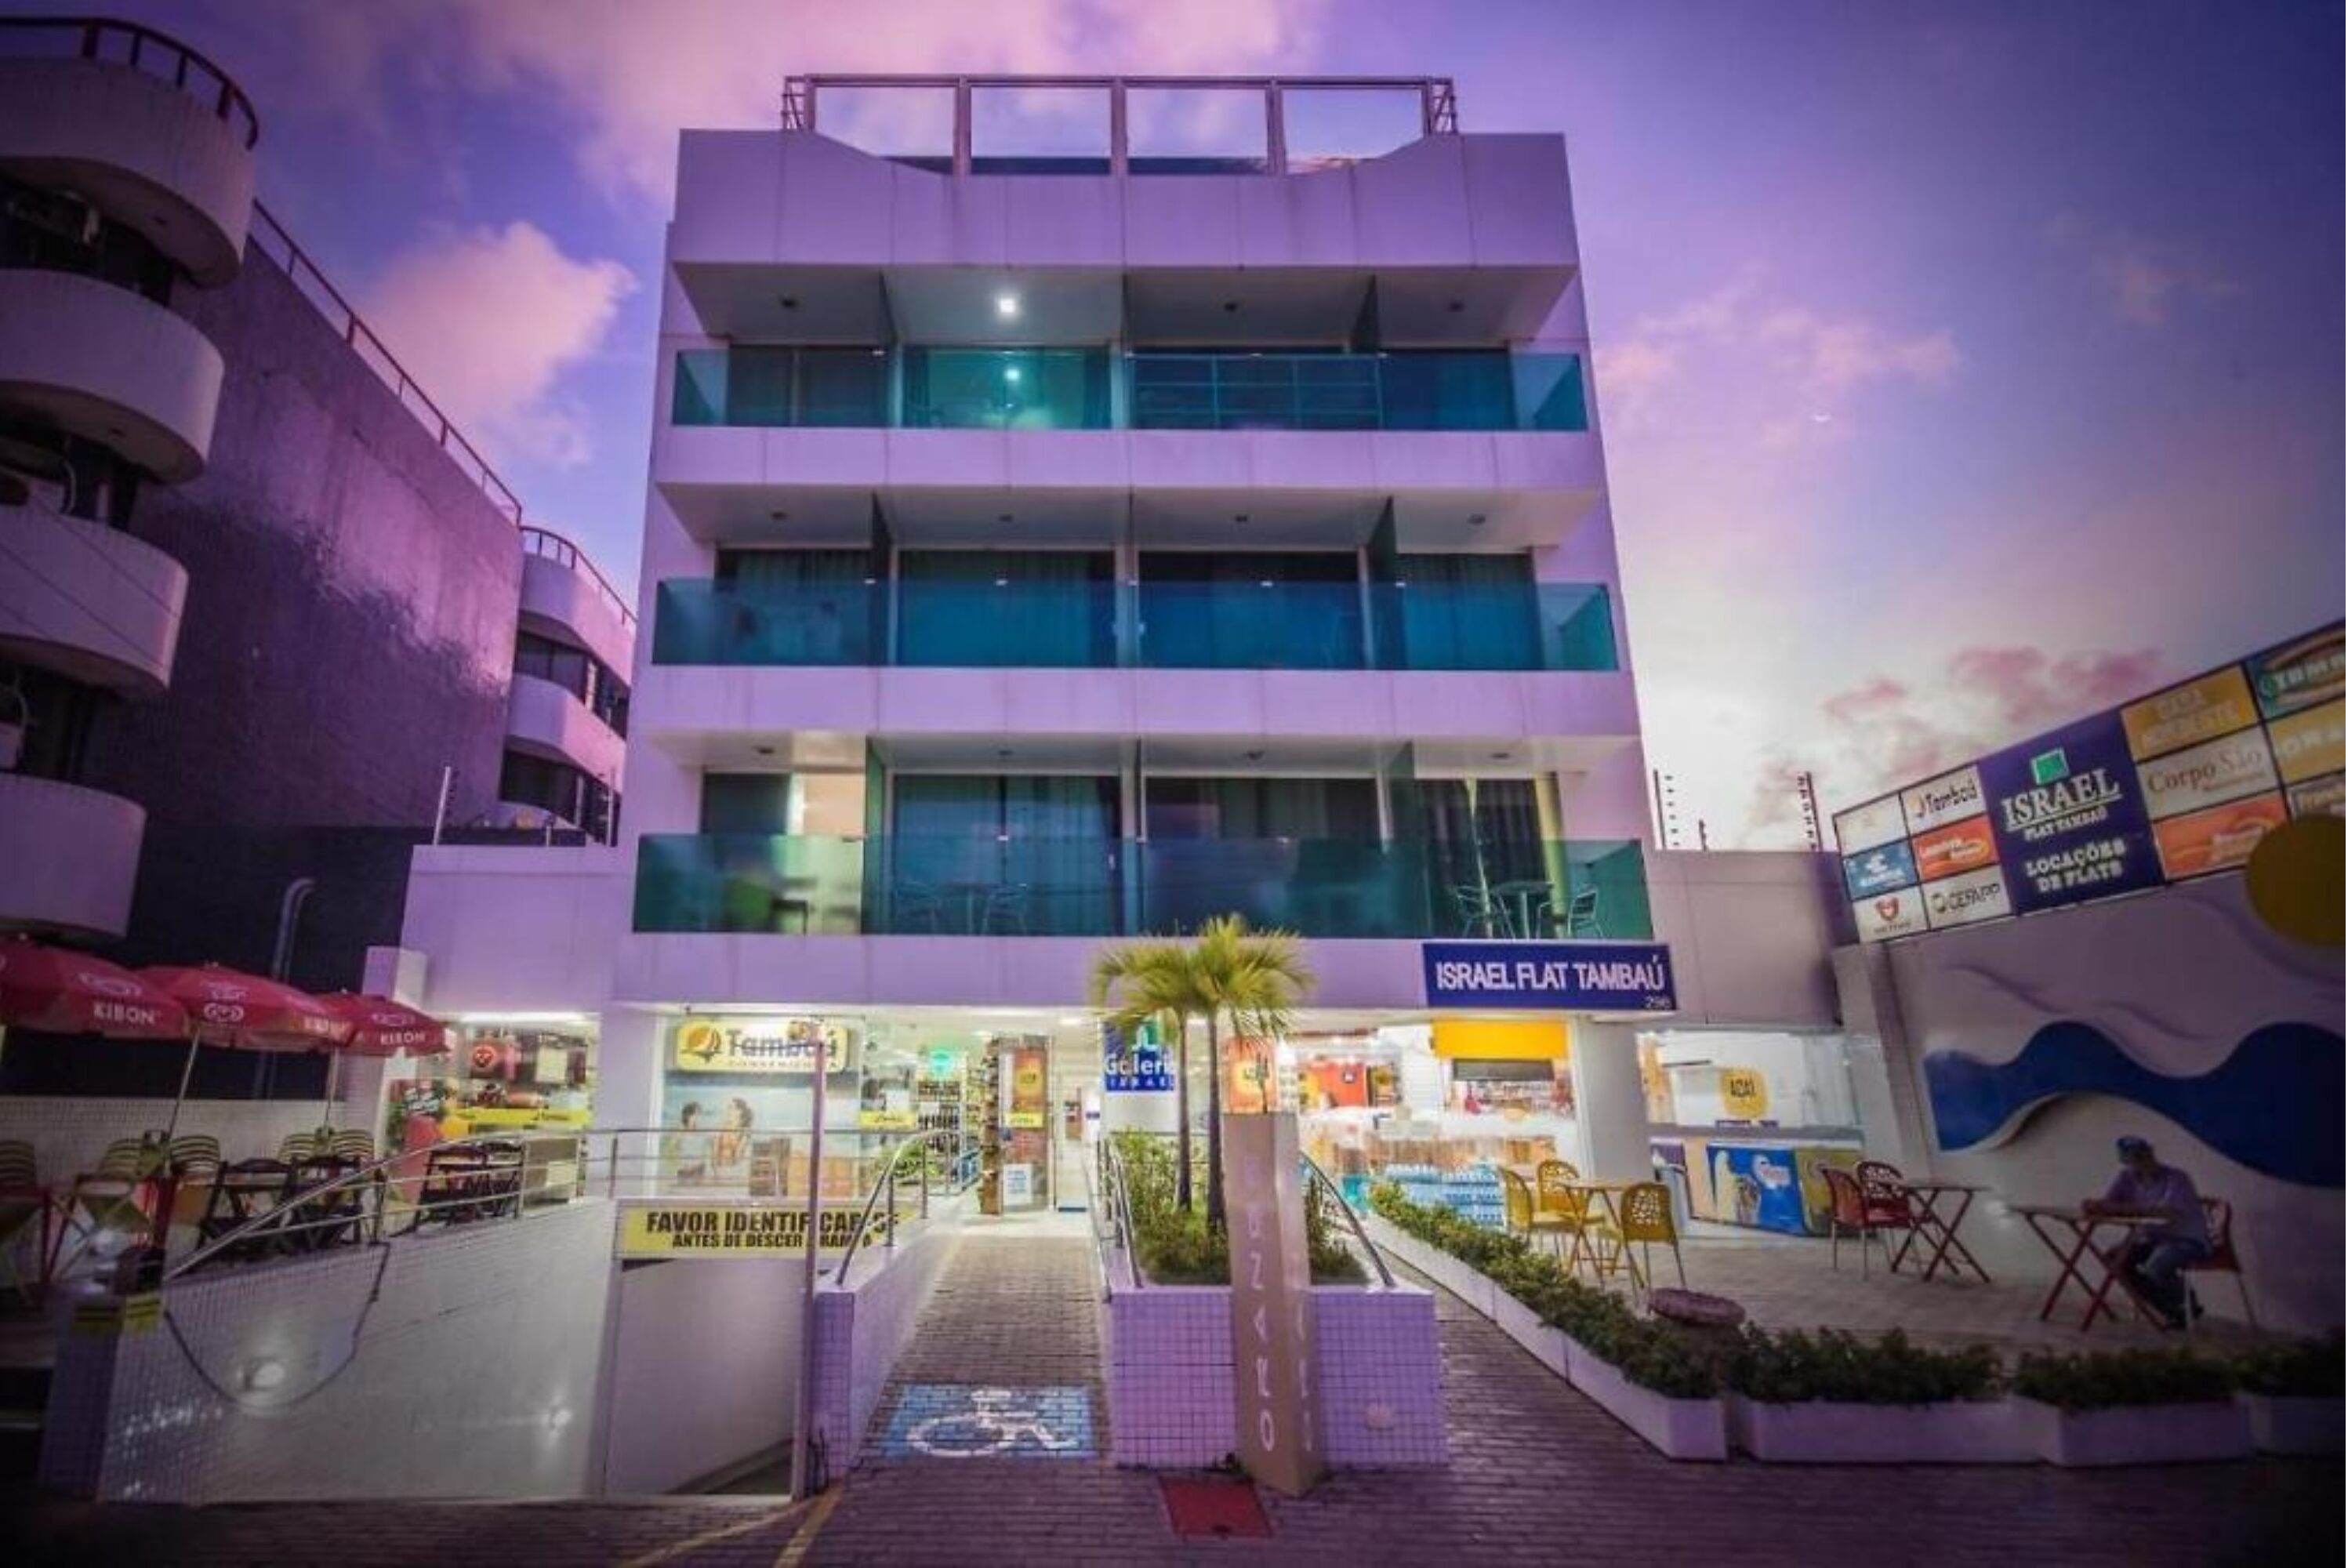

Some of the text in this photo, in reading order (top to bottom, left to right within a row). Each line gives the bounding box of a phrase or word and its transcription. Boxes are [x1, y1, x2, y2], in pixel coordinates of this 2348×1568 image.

[2148, 759, 2217, 793] Corpo
[2001, 768, 2121, 826] ISRAEL
[2038, 873, 2063, 892] DE
[1435, 954, 1664, 991] ISRAEL FLAT TAMBAÚ
[93, 1001, 155, 1025] KIBON
[380, 1031, 426, 1046] KIBON
[1105, 1052, 1174, 1076] Galeri
[647, 1211, 718, 1233] FAVOR
[673, 1233, 720, 1248] ANTES
[745, 1233, 803, 1248] DESCER
[819, 1233, 873, 1248] RAMA
